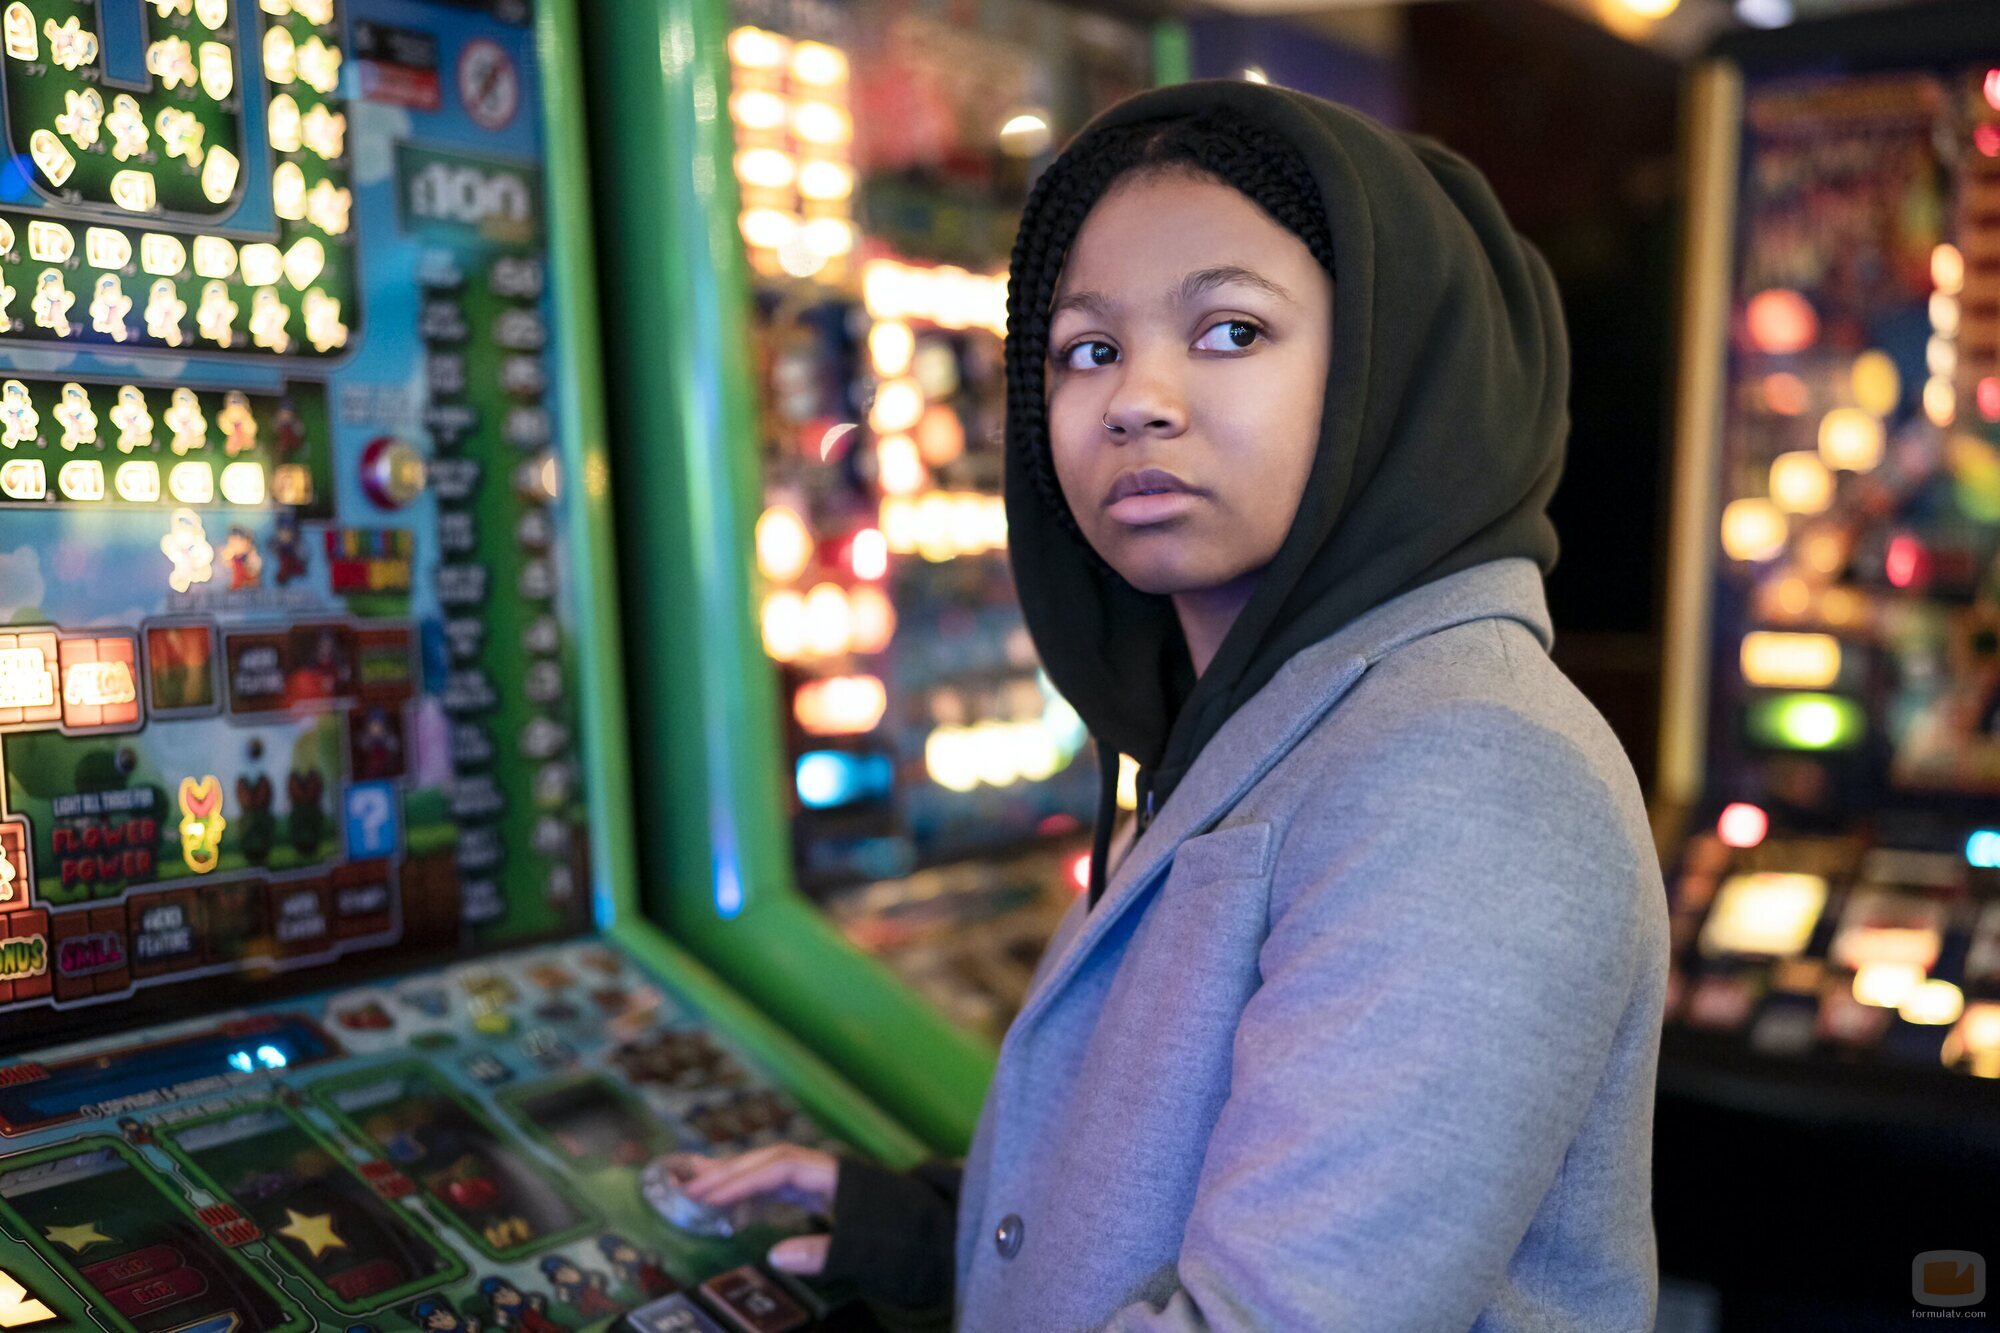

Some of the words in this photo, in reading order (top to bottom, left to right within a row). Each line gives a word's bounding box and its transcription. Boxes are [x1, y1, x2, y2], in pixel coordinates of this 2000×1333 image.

[52, 818, 156, 855] FLOWER
[62, 848, 151, 885] POWER
[61, 935, 122, 973] SKILL
